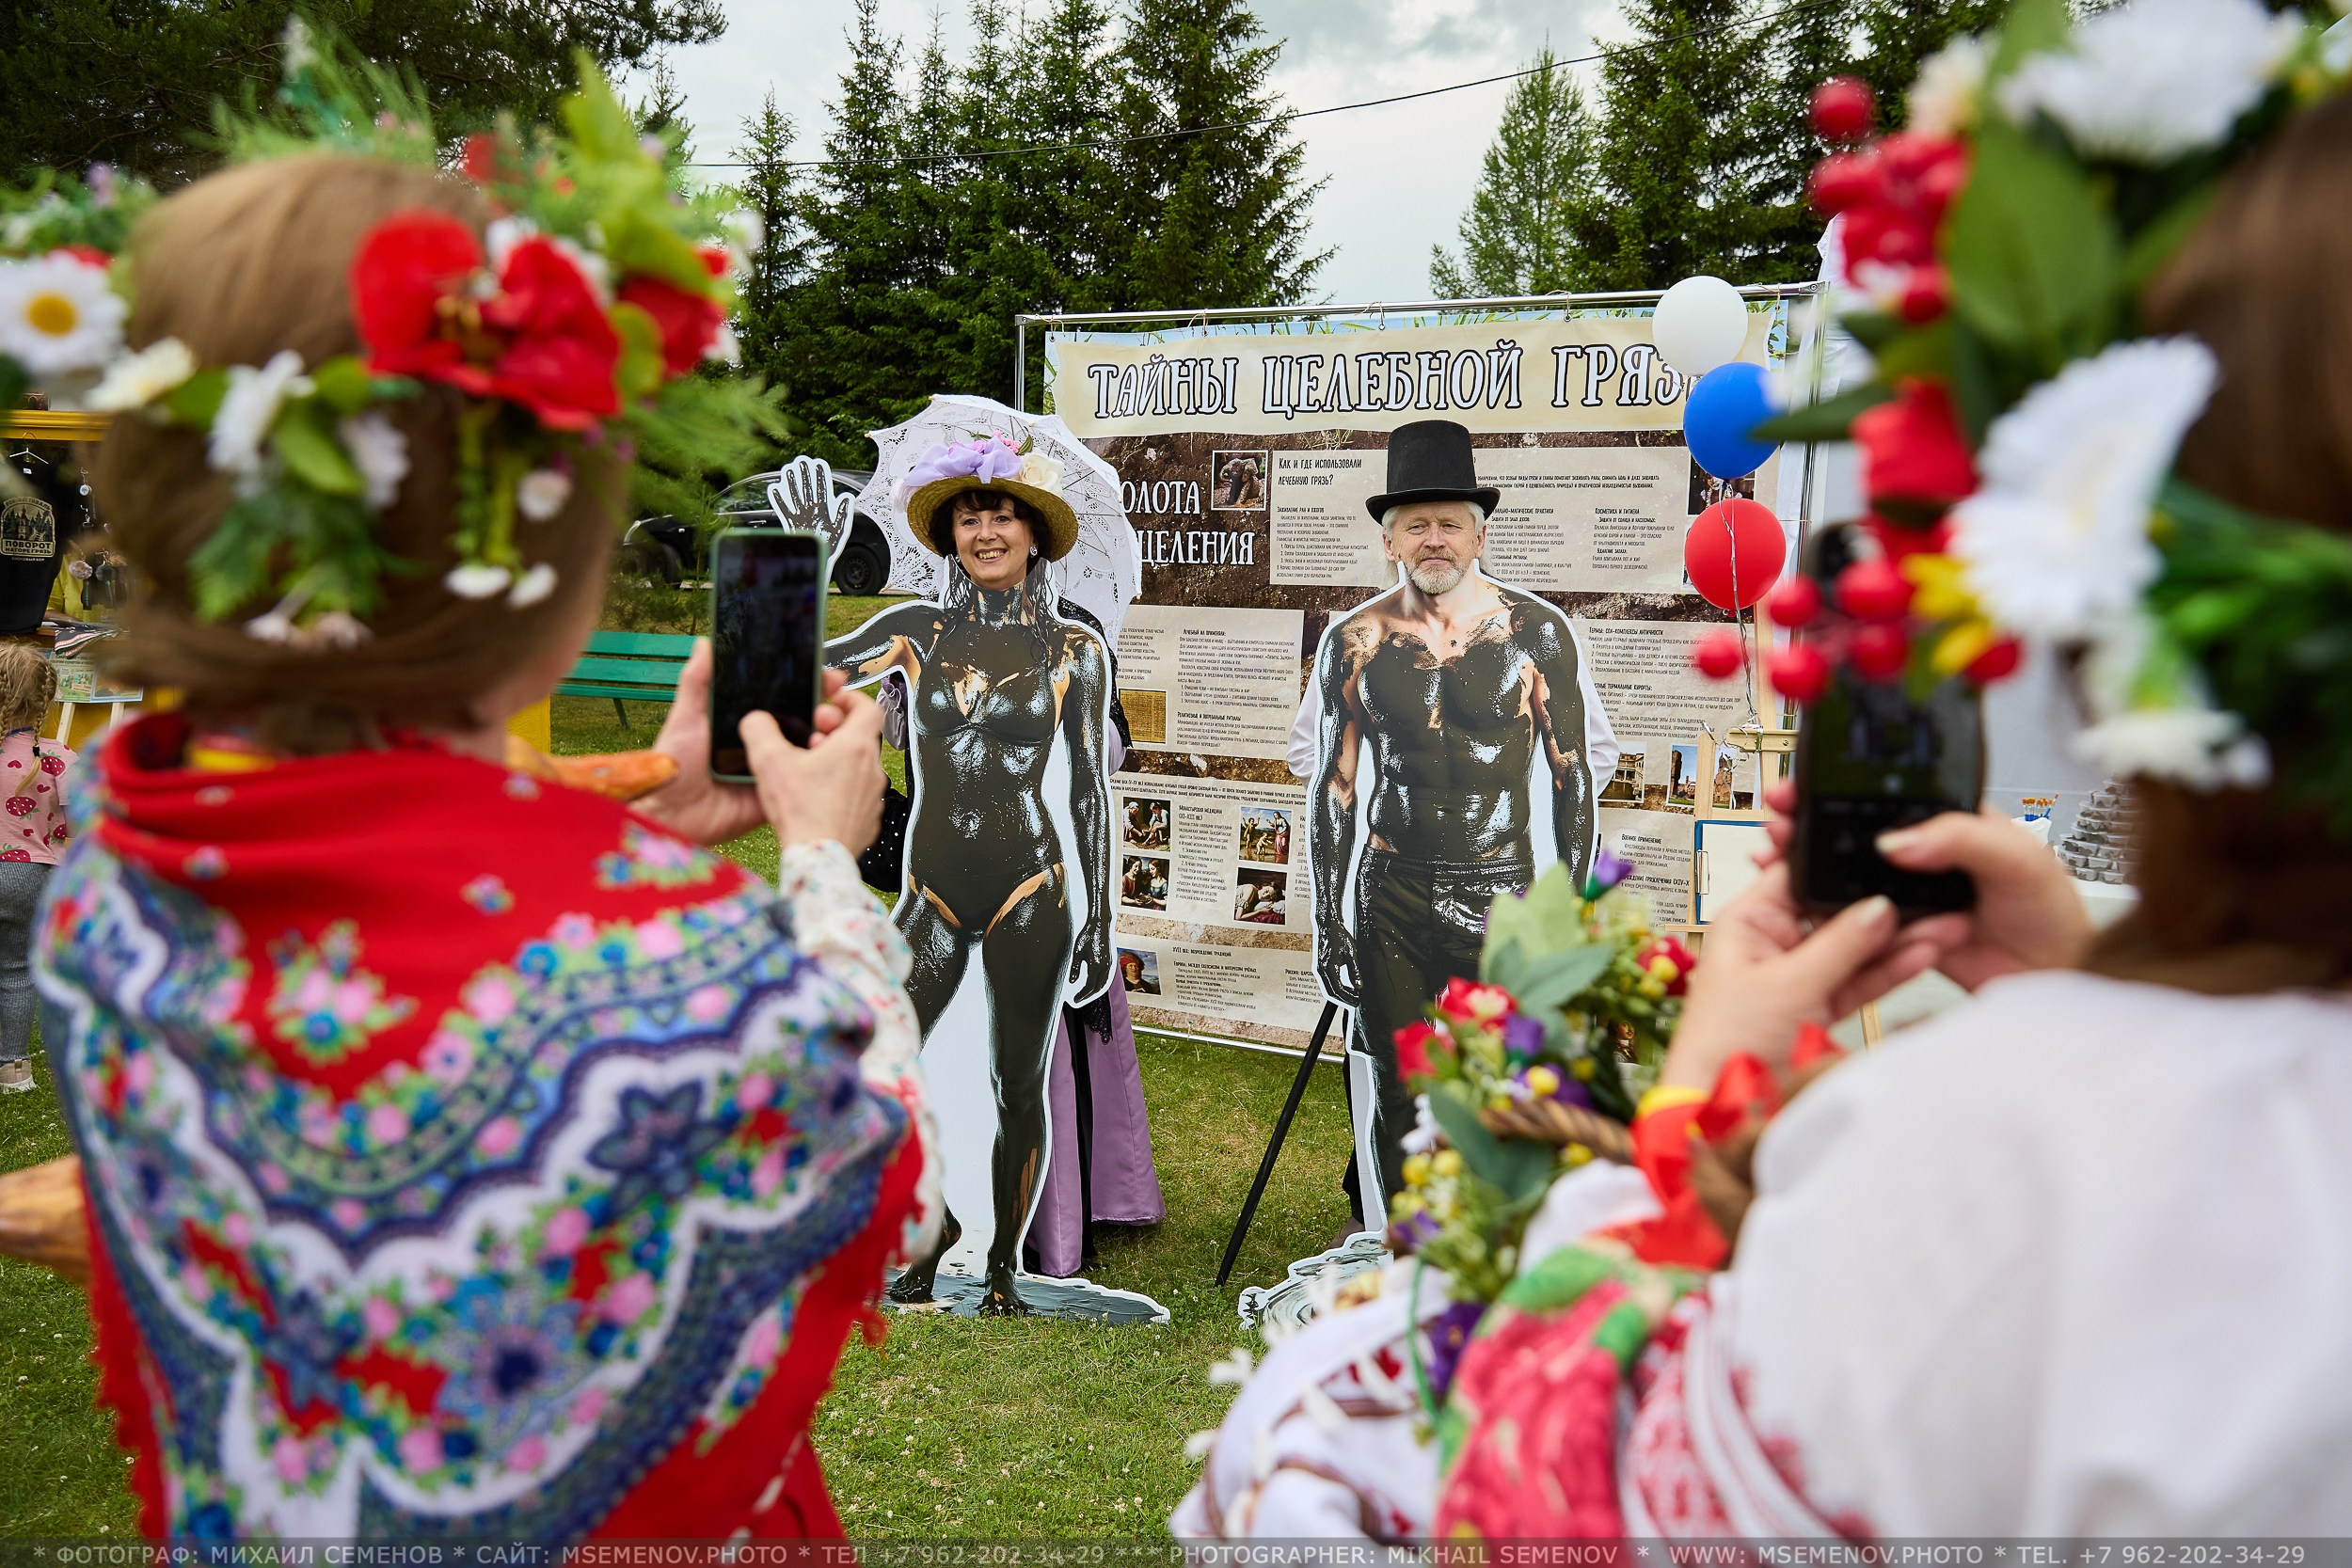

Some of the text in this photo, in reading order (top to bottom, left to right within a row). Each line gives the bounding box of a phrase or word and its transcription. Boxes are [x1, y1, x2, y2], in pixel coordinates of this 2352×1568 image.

[1088, 339, 1693, 420] ТАЙНЫ ЦЕЛЕБНОЙ ГРЯЗ
[1279, 458, 1361, 469] КАК И ГДЕ ИСПОЛЬЗОВАЛИ
[1279, 474, 1333, 485] ЛЕЧЕБНУЮ ГРЯЗЬ?
[1120, 480, 1200, 515] ОЛОТА
[1136, 529, 1256, 567] ЦЕЛЕНИЯ
